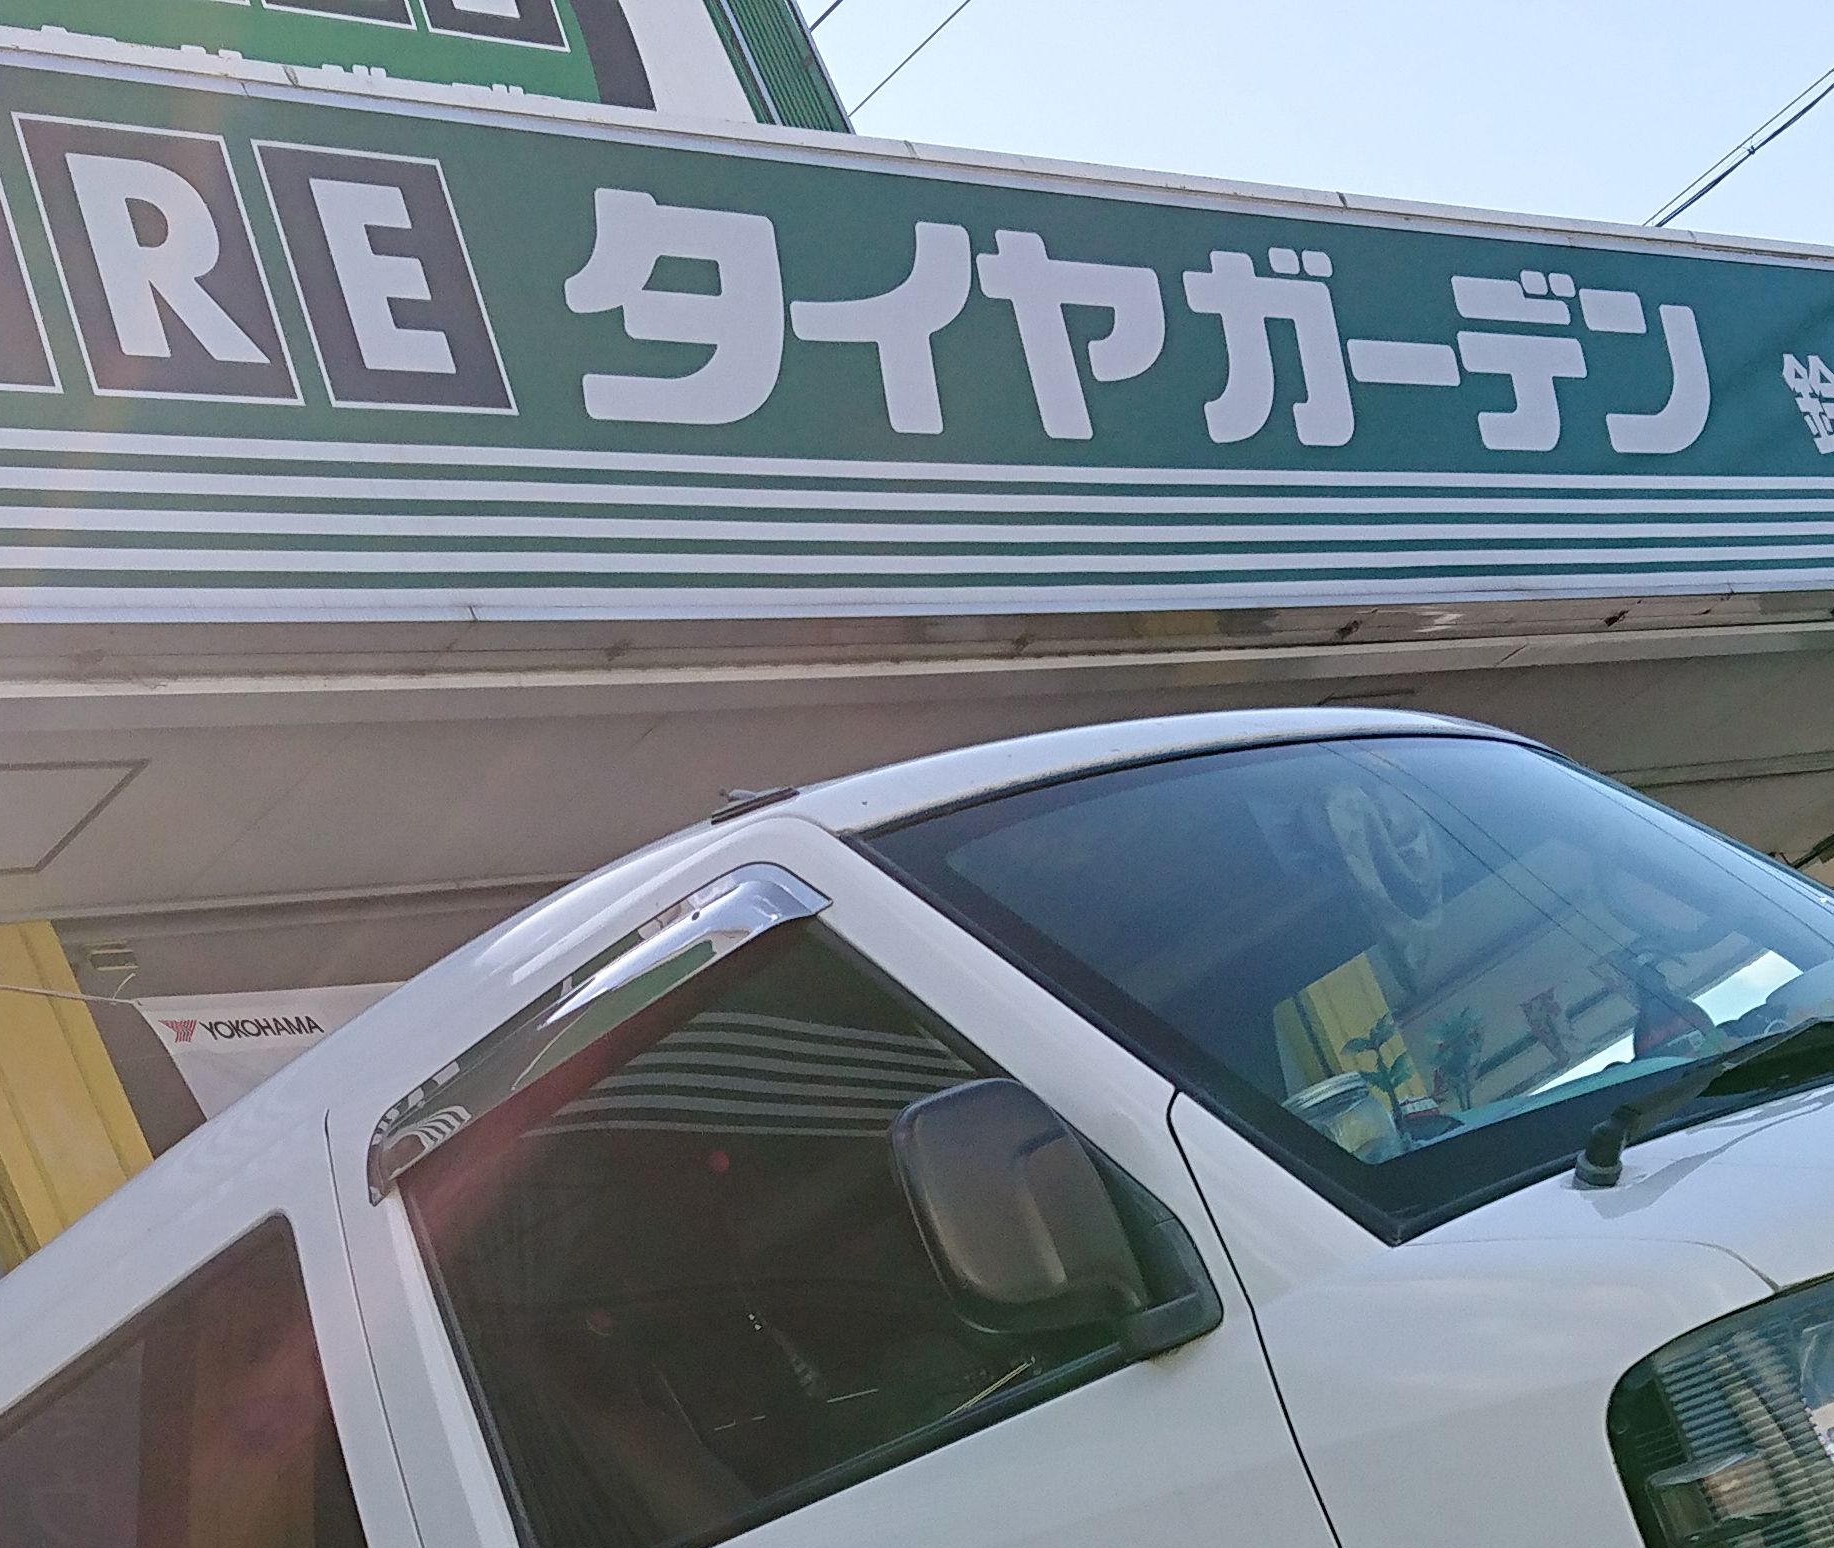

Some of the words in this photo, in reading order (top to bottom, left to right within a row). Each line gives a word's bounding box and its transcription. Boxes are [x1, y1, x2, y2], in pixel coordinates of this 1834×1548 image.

[562, 187, 1713, 456] タイヤガーデン
[199, 1015, 325, 1041] YOKOHAMA
